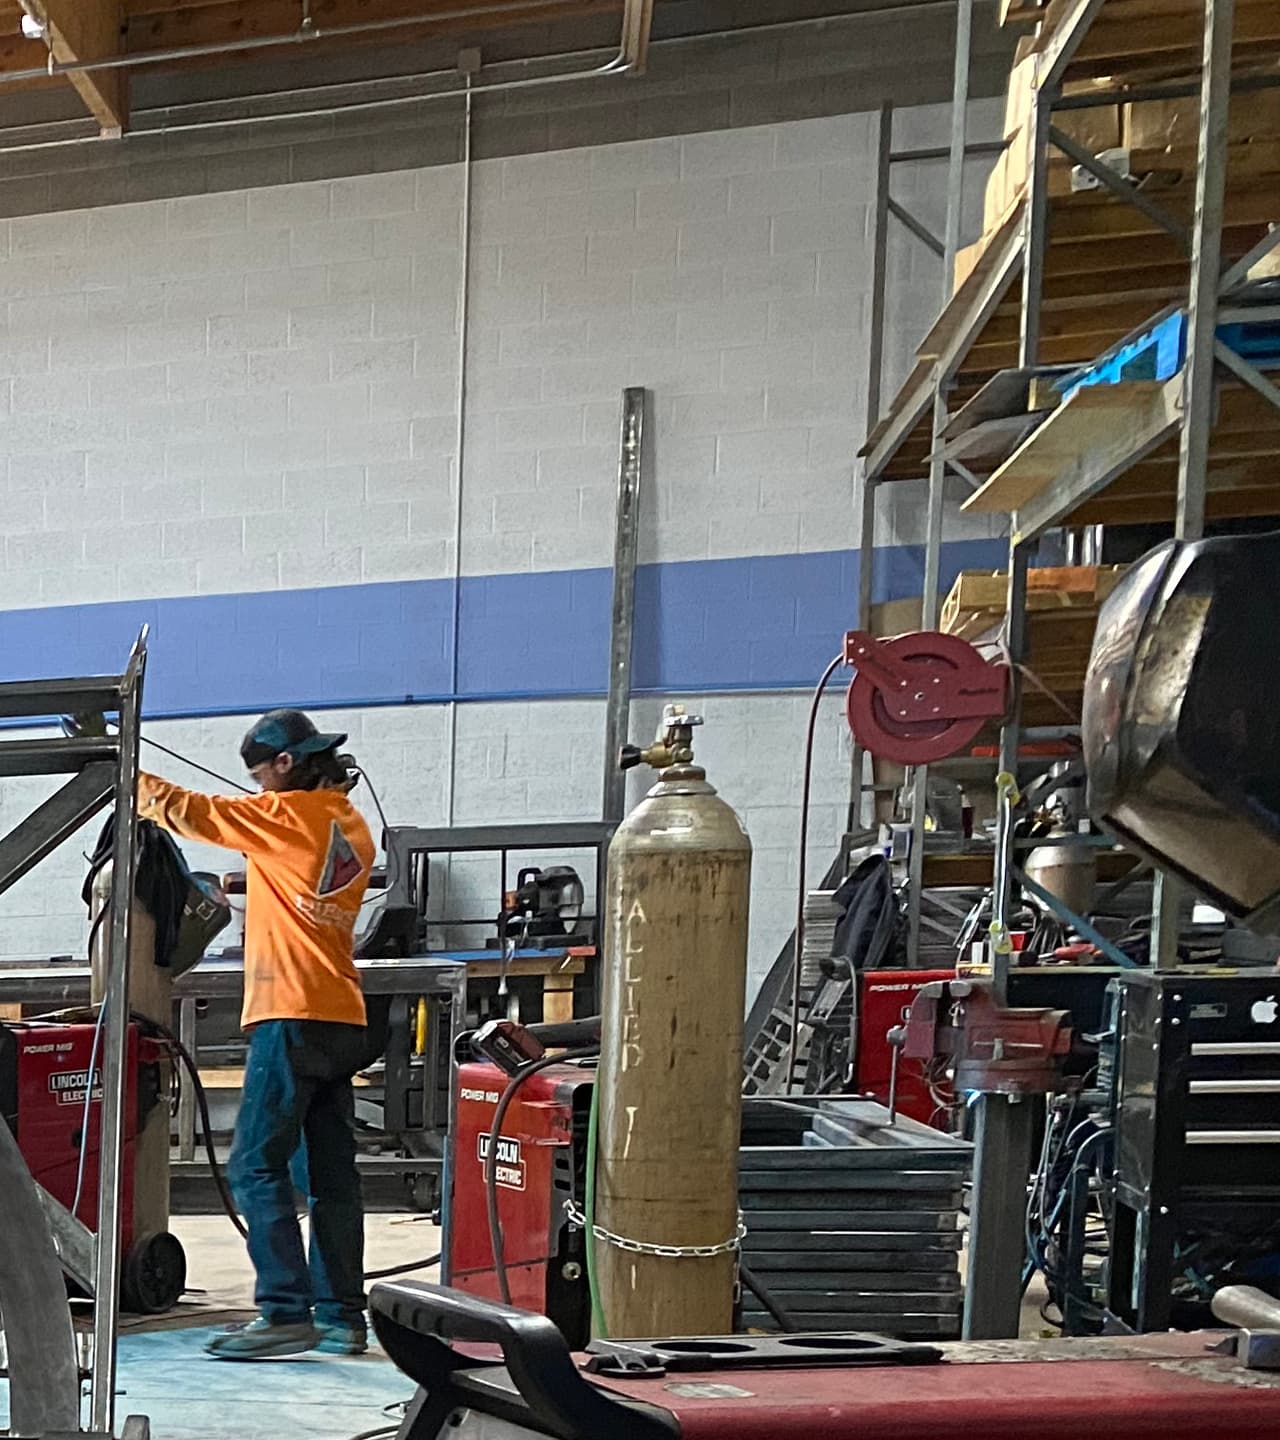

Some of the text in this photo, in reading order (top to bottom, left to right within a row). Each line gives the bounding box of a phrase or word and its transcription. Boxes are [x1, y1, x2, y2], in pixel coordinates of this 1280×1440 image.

[23, 1042, 73, 1054] POWER MIG
[62, 1088, 103, 1102] ELECTIC
[460, 1088, 499, 1103] POWER MIG
[480, 1137, 518, 1163] LICOLN
